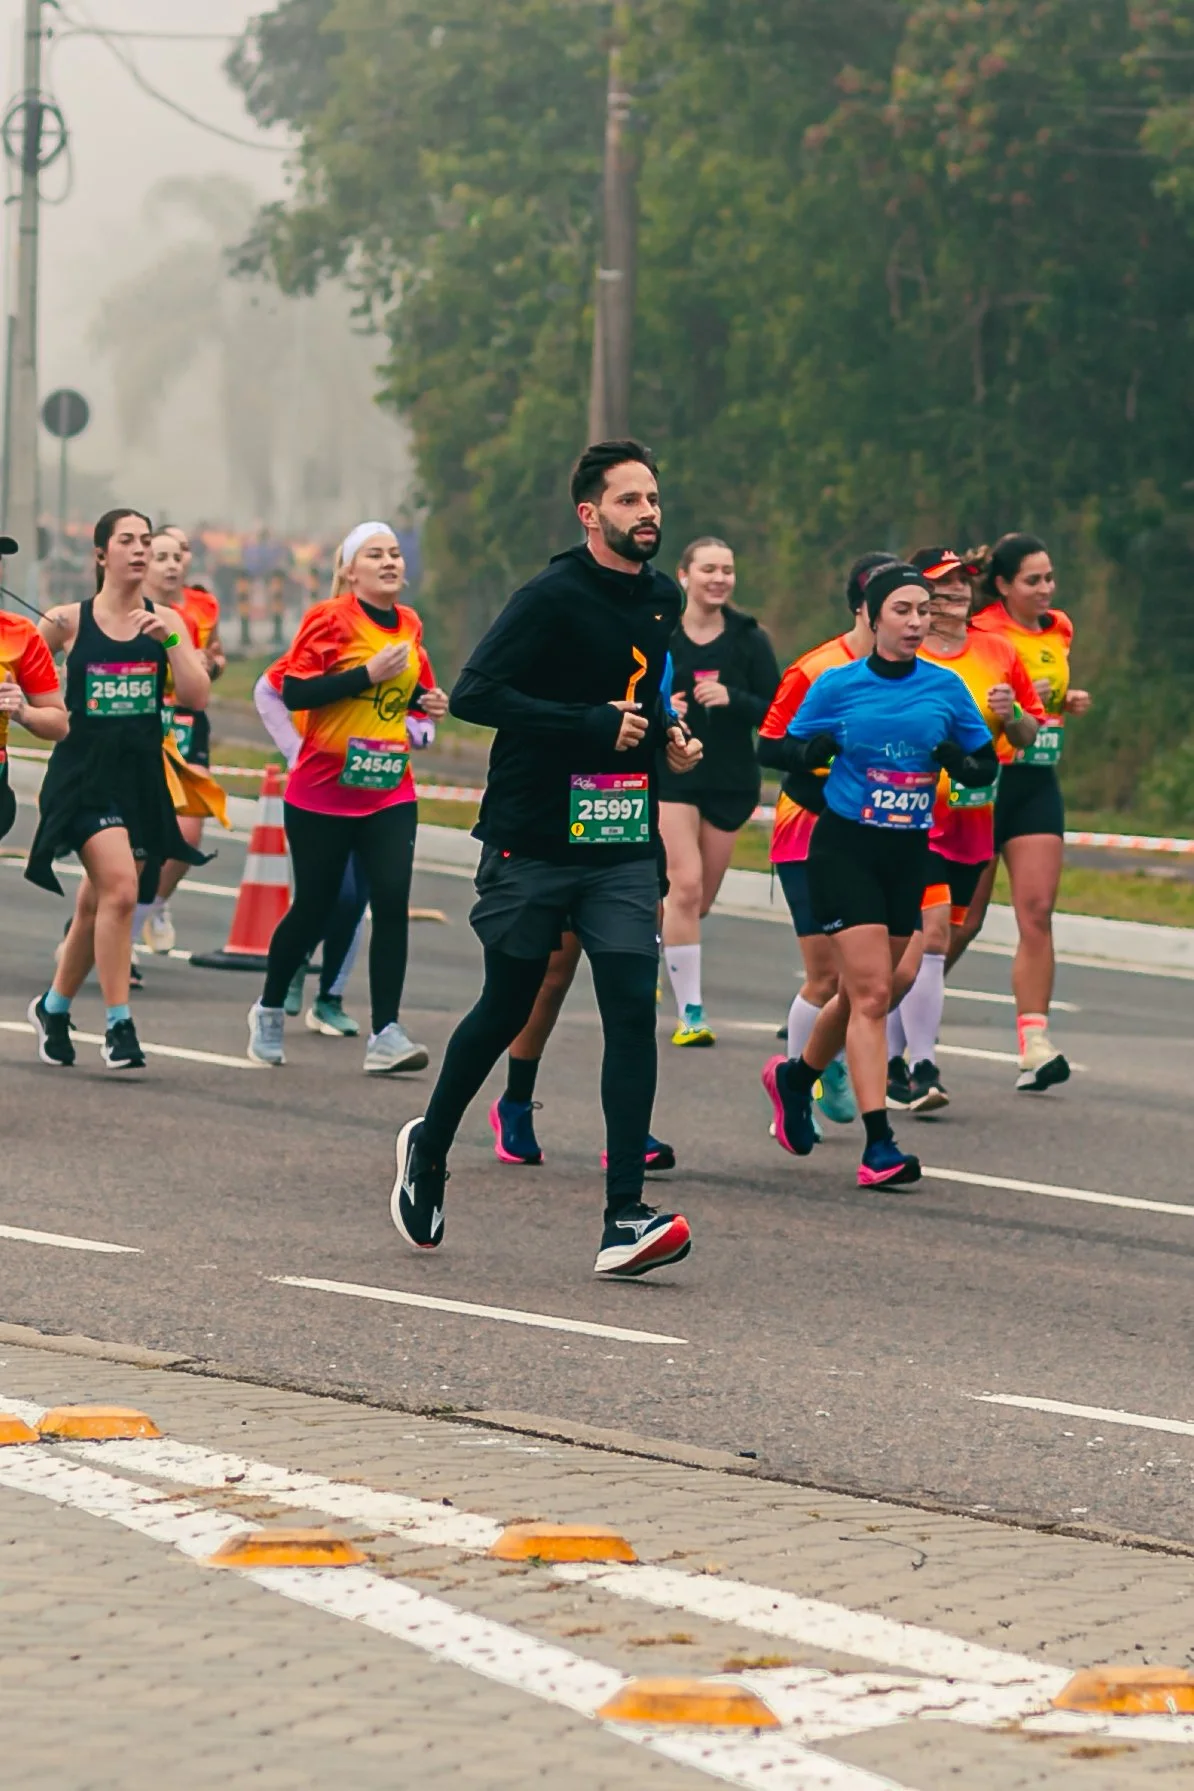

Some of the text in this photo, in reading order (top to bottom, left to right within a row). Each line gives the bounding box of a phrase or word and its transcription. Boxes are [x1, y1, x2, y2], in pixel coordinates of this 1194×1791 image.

[92, 681, 152, 698] 25456
[350, 756, 403, 773] 24546
[578, 799, 644, 820] 25997
[871, 789, 930, 811] 12470
